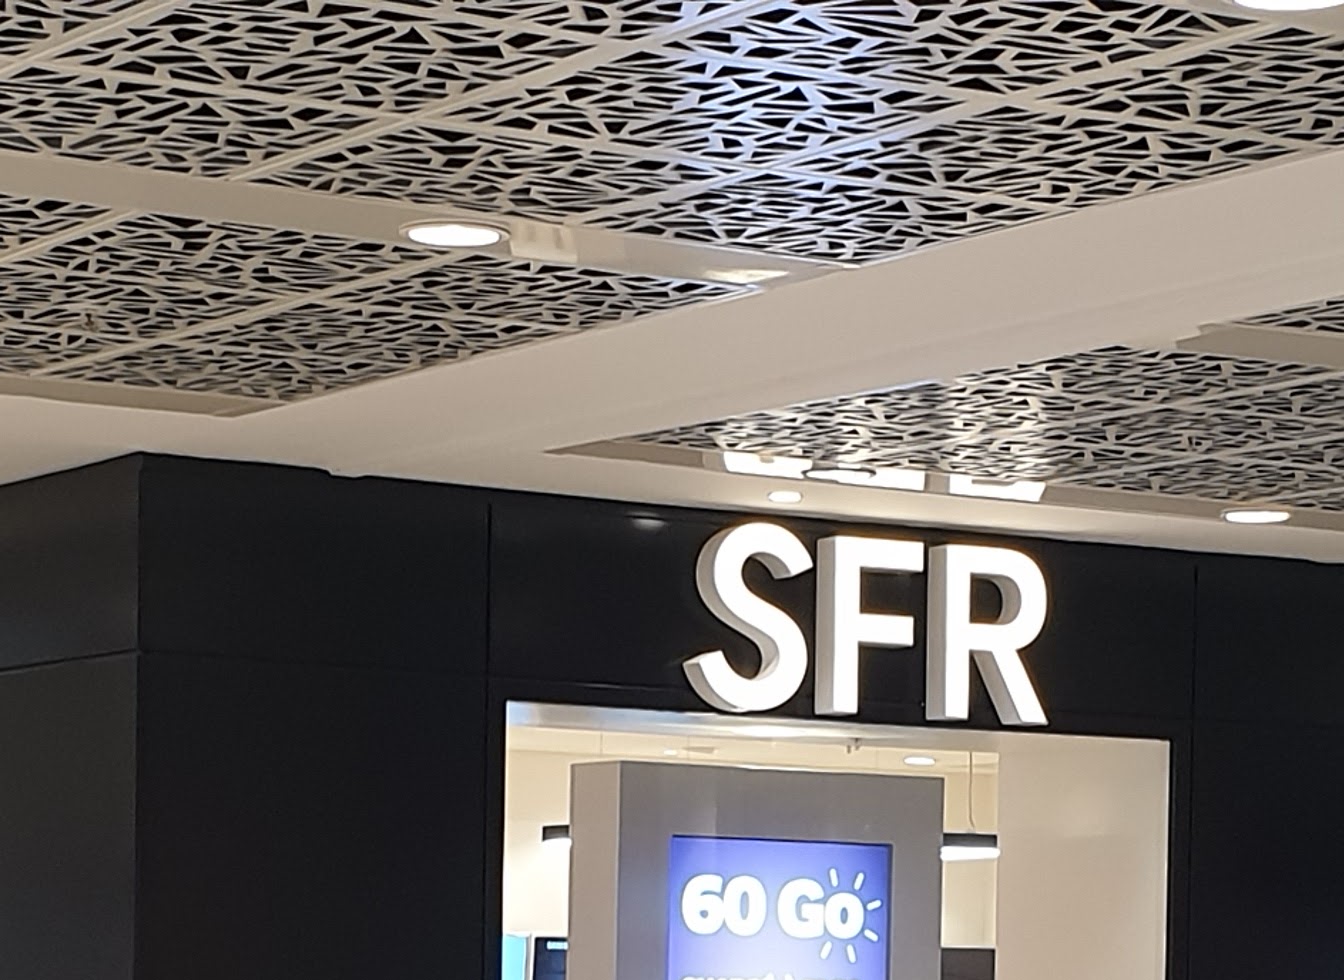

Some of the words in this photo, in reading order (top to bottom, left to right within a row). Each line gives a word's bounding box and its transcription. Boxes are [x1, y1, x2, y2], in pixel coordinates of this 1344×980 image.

[683, 521, 1049, 726] SFR
[681, 873, 768, 937] 60
[777, 877, 866, 940] Go
